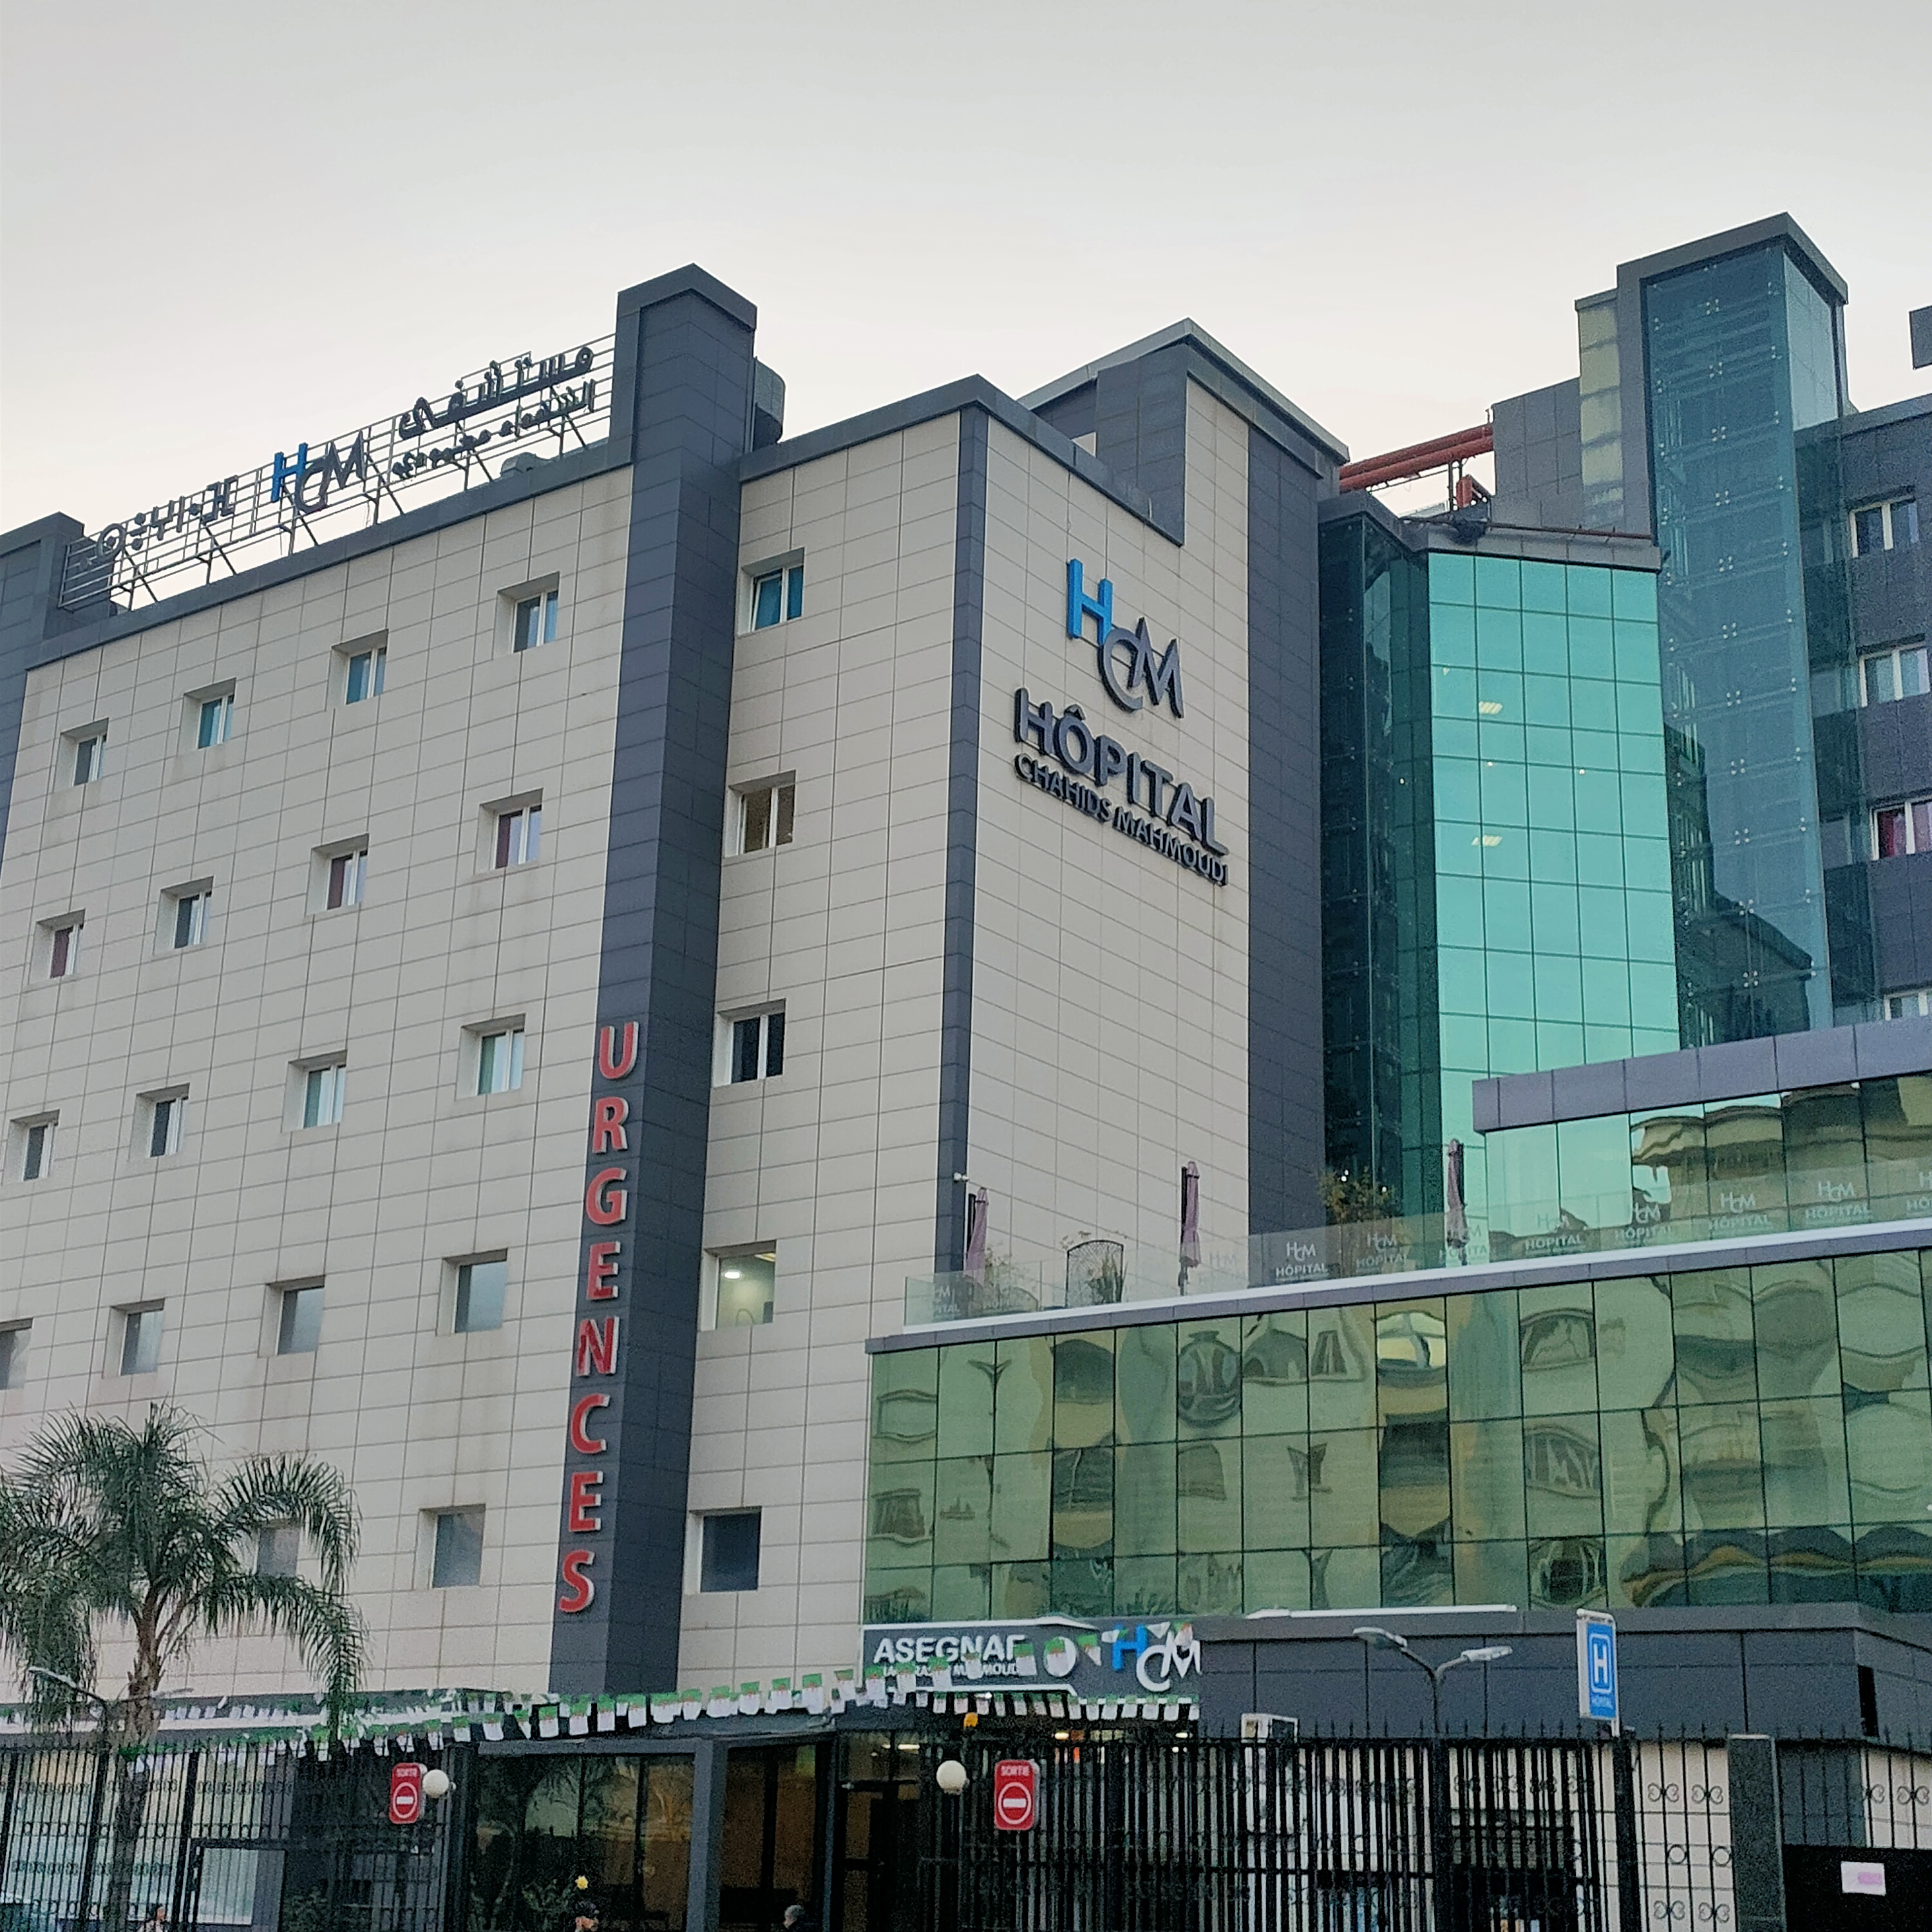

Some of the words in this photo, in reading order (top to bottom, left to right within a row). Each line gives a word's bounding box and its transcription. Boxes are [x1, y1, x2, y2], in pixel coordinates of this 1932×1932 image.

[399, 346, 594, 440] مستشفى
[271, 431, 366, 515] HCM
[1067, 558, 1184, 718] HCM
[1014, 687, 1229, 855] HÔPITAL
[1014, 753, 1113, 822] CHAHIDS
[1113, 806, 1228, 886] MAHMOUDI
[558, 1021, 639, 1613] URGENCES
[1593, 1643, 1608, 1684] H
